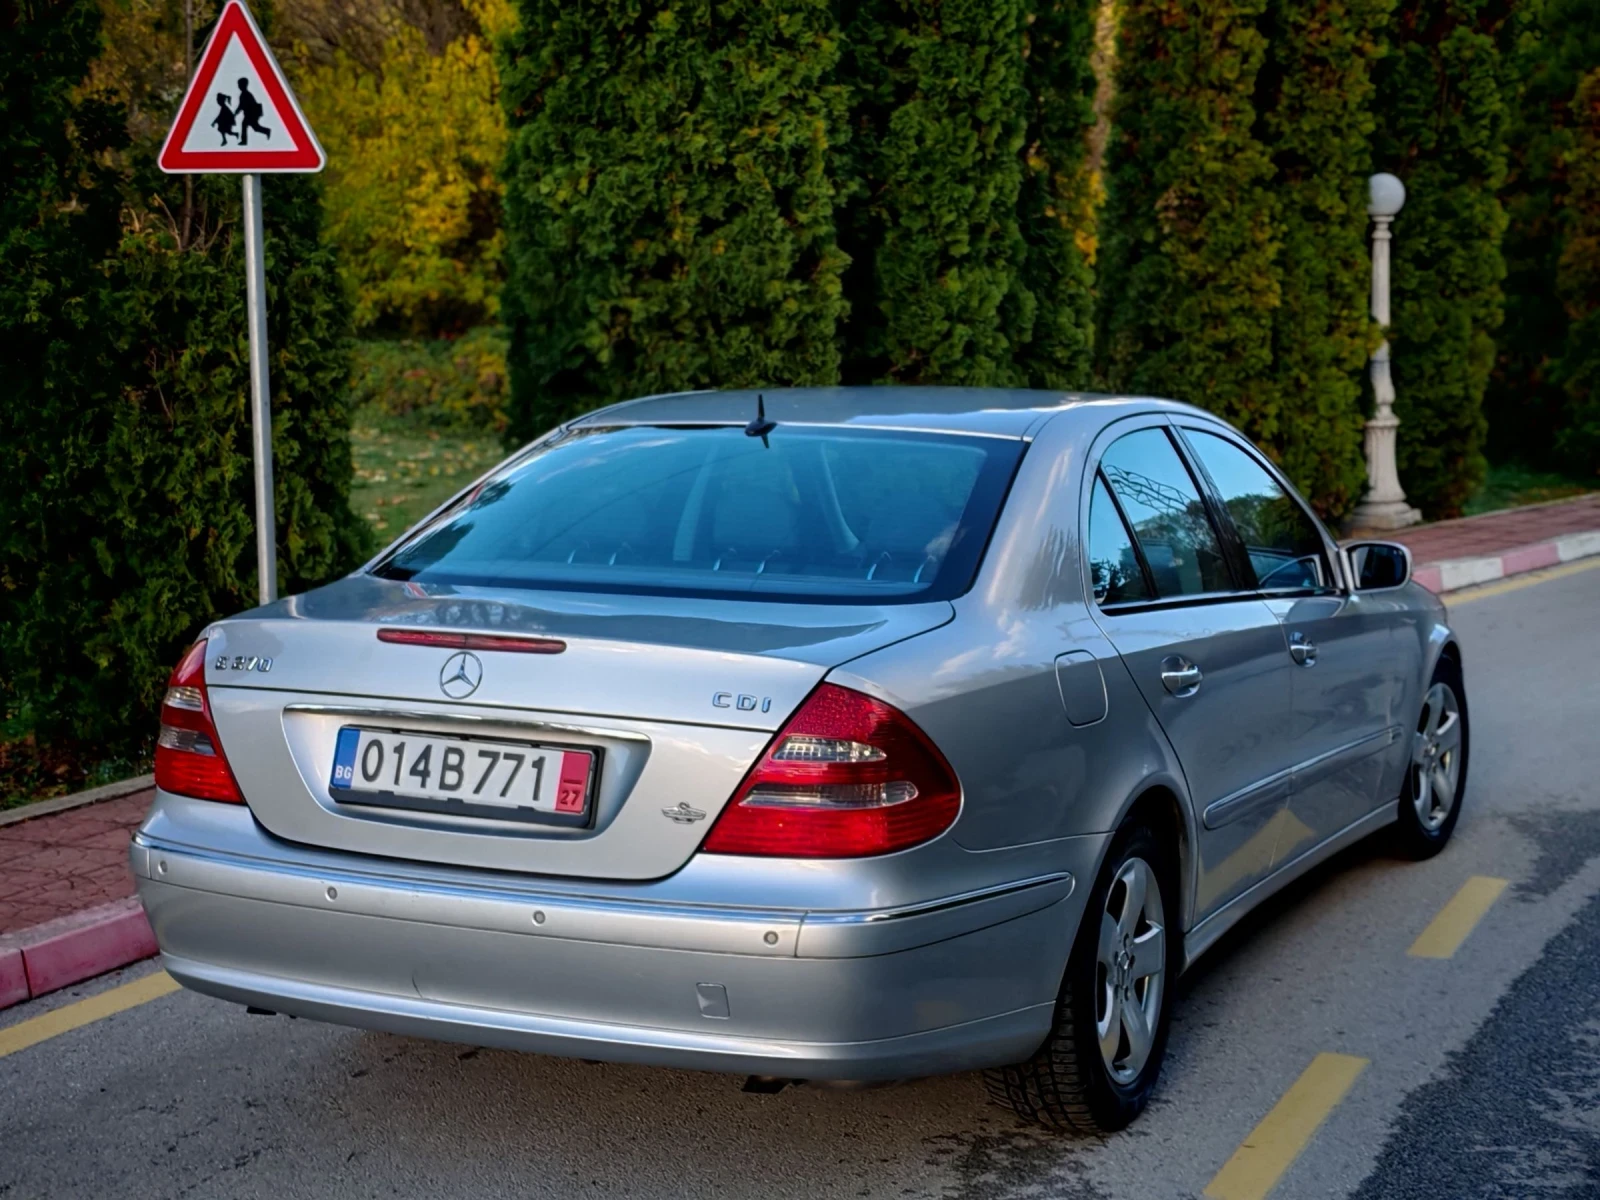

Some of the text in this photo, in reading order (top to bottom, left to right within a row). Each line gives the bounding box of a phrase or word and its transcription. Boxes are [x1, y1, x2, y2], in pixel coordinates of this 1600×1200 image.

[215, 656, 228, 671] E
[712, 691, 772, 714] CDI
[335, 764, 352, 780] BG
[560, 789, 581, 806] 27
